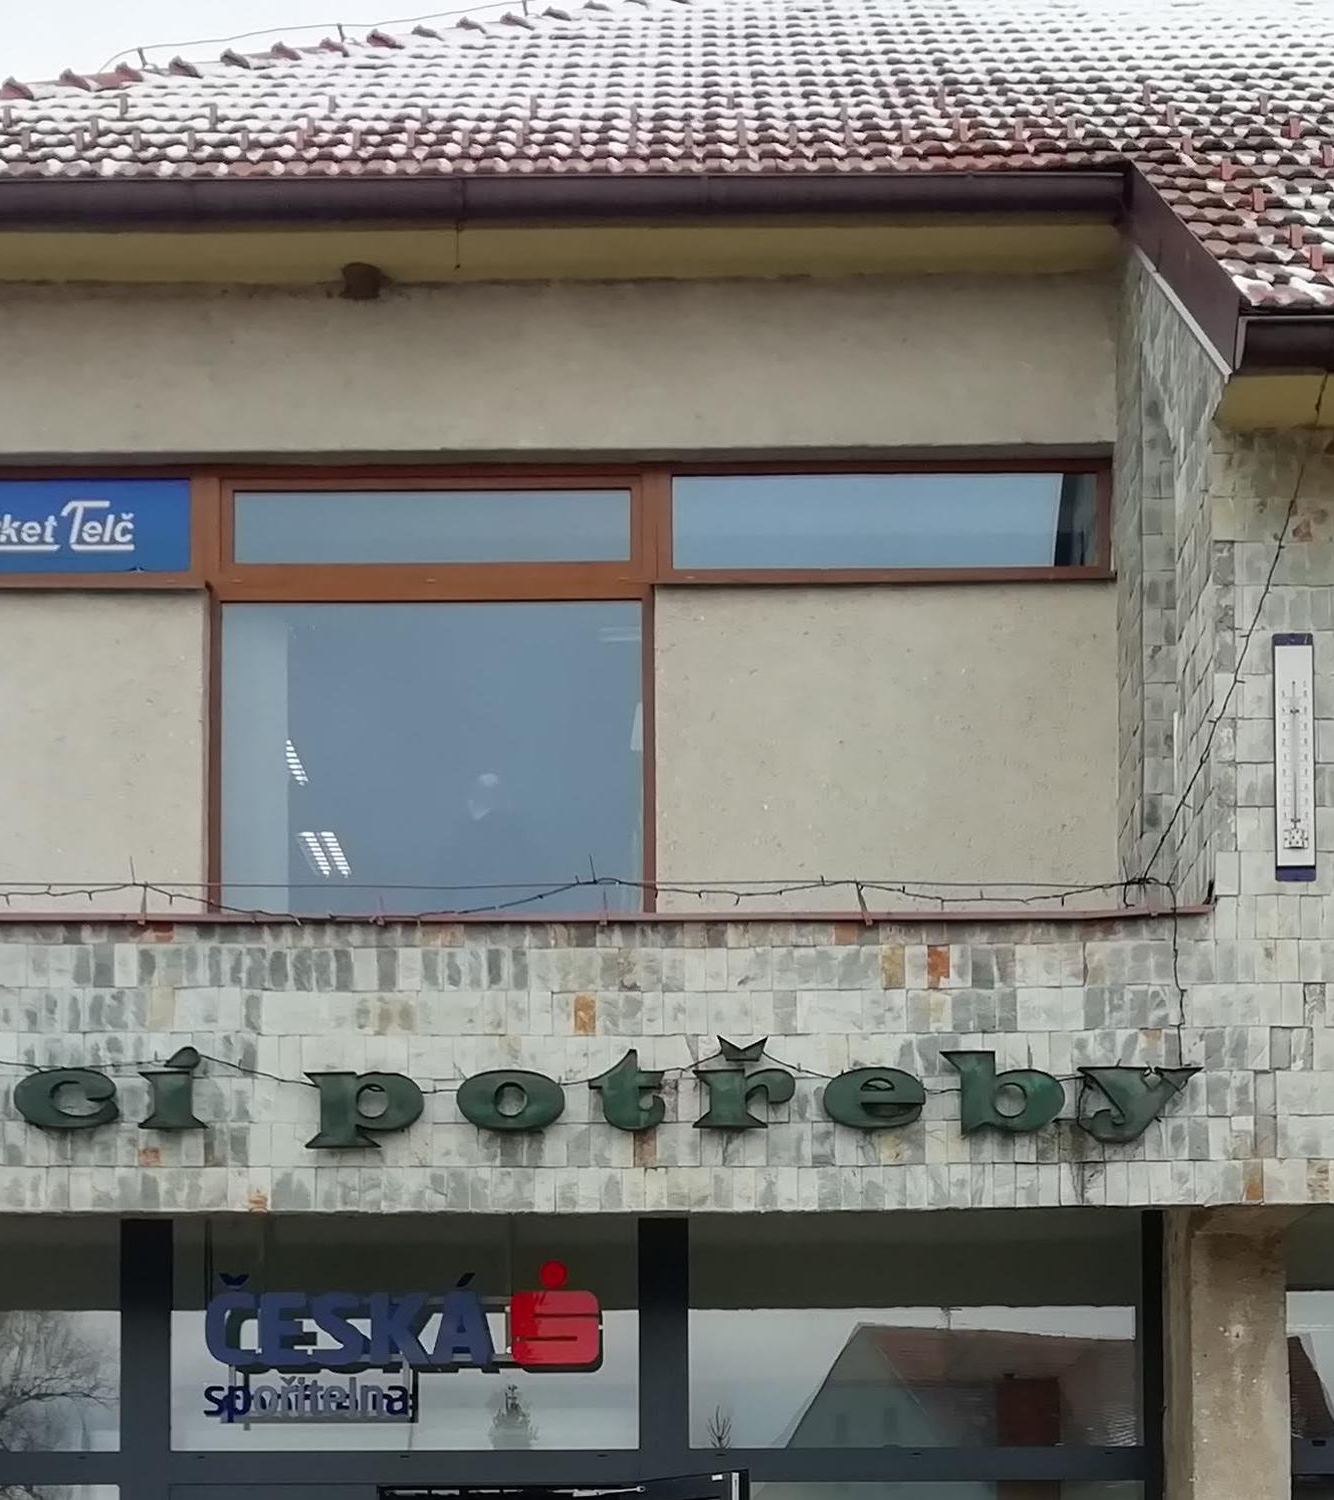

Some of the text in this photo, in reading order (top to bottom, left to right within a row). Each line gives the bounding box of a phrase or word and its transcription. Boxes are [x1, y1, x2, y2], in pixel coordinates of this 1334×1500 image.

[61, 499, 135, 552] Telč
[304, 1034, 1203, 1149] potřeby
[205, 1272, 495, 1366] ČESKÁ
[203, 1376, 411, 1423] spořitelna
